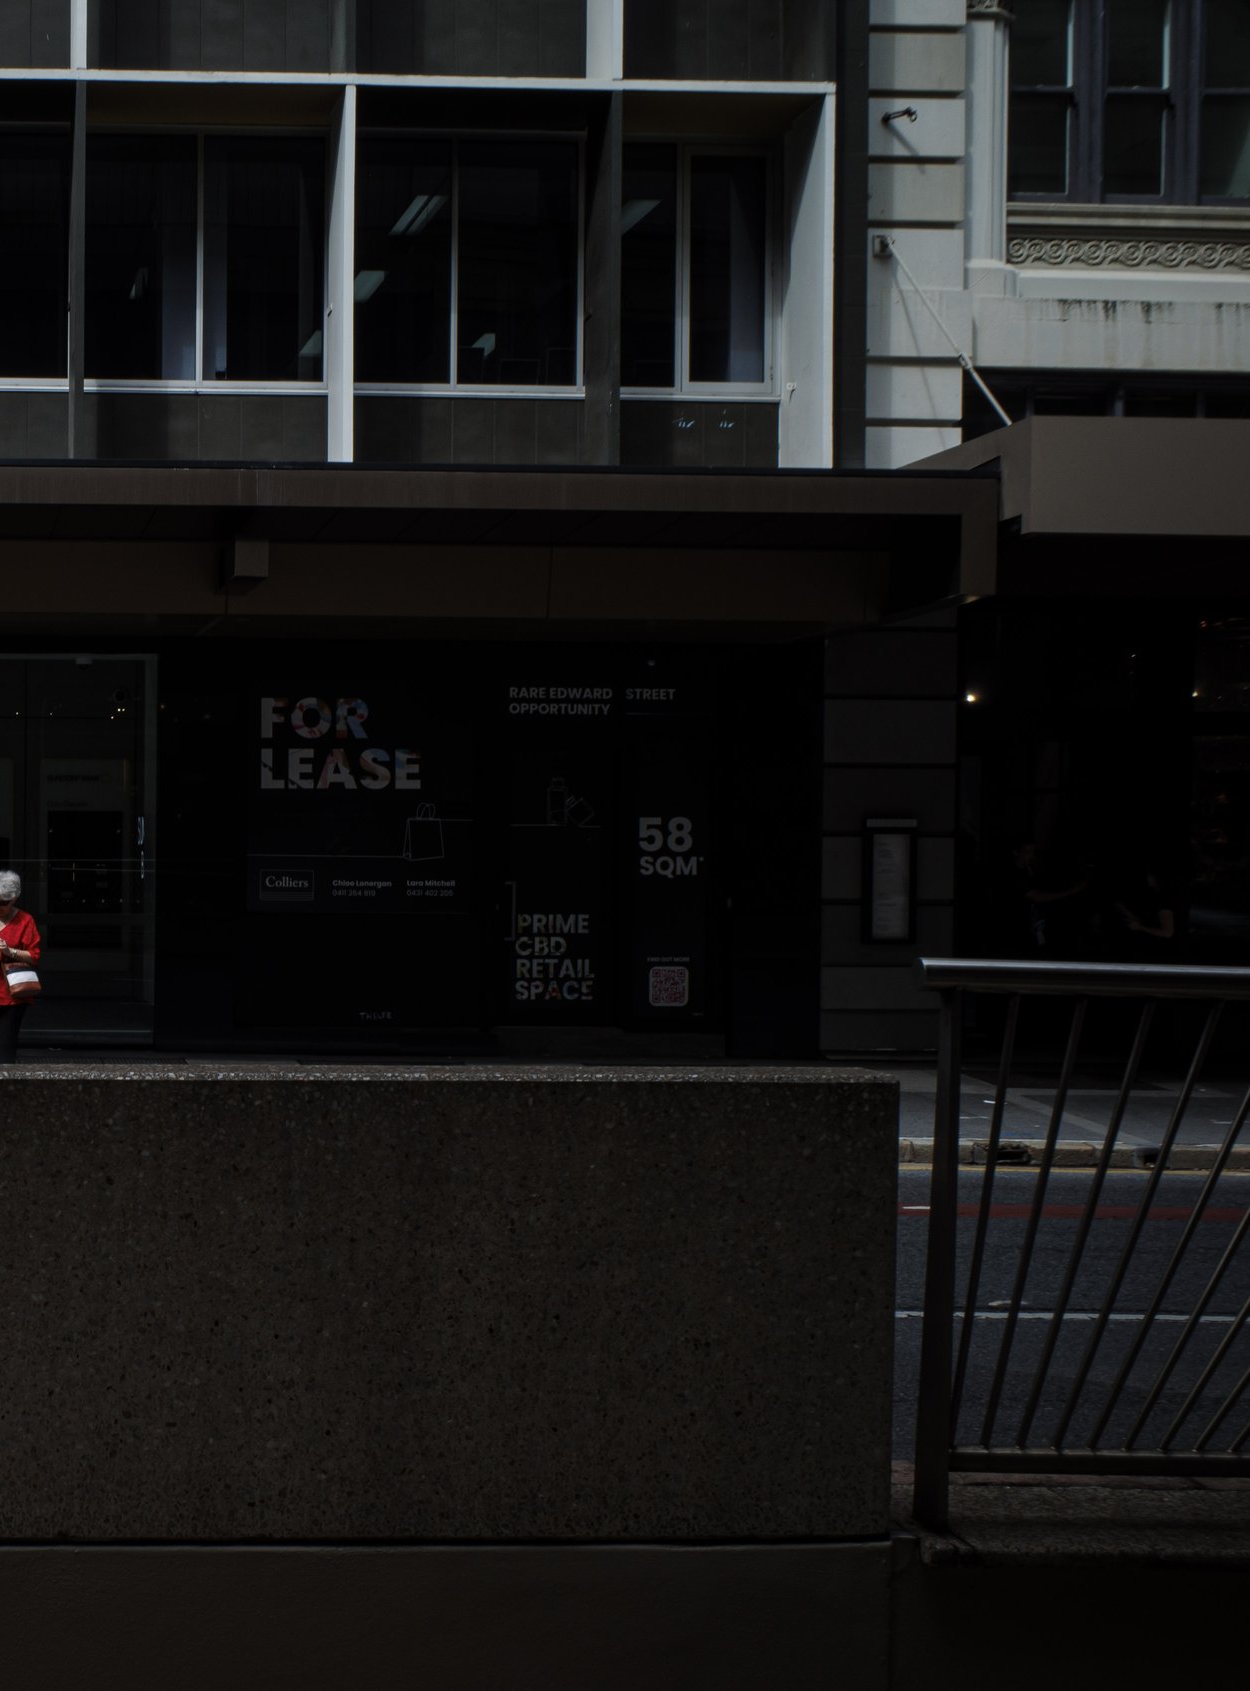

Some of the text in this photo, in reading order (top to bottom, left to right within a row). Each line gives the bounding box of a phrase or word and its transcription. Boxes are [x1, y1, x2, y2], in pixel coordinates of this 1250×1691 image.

[509, 687, 676, 701] RARE EDWARD STREET
[261, 697, 369, 739] FOR
[509, 703, 611, 715] OPPORTUNITY
[261, 748, 422, 790] LEASE
[639, 816, 693, 853] 58
[265, 875, 309, 888] Colliers
[517, 913, 590, 934] PRIME
[515, 936, 567, 956] CBD
[516, 959, 595, 979] RETAIL
[515, 980, 593, 1001] SPACE
